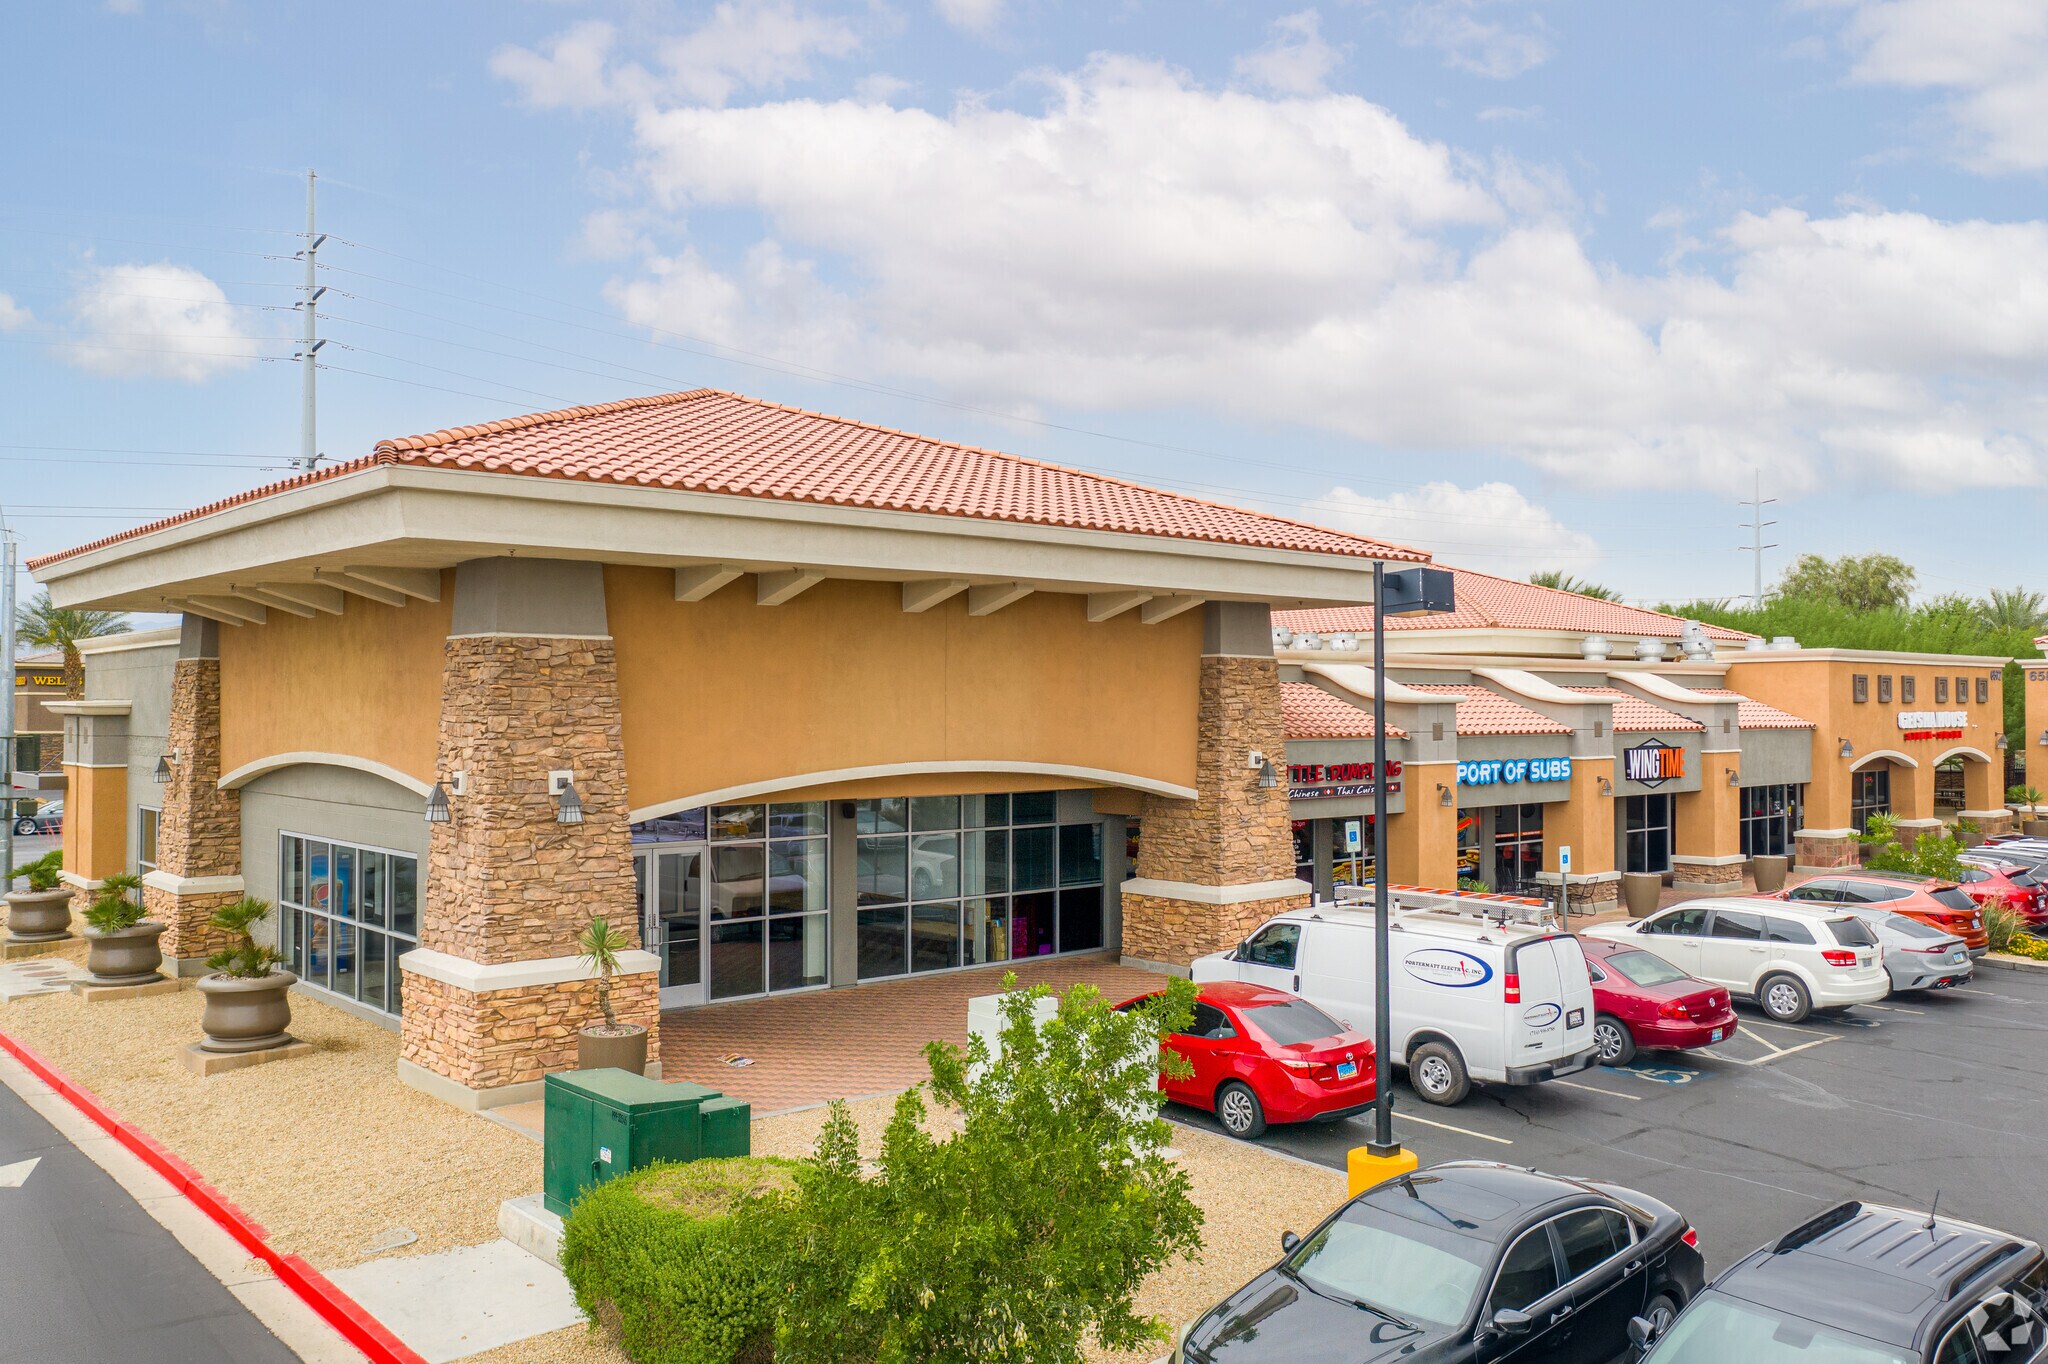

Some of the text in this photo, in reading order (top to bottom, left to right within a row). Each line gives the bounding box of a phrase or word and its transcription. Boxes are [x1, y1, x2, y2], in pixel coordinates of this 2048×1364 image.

[33, 676, 83, 686] WEL
[2029, 671, 2048, 682] 65
[1330, 760, 1402, 782] DUMPLNG
[1457, 759, 1571, 784] PORT OF SUBS
[1629, 748, 1686, 779] WINGTIME
[1288, 785, 1375, 799] Chinese Thai Cuis
